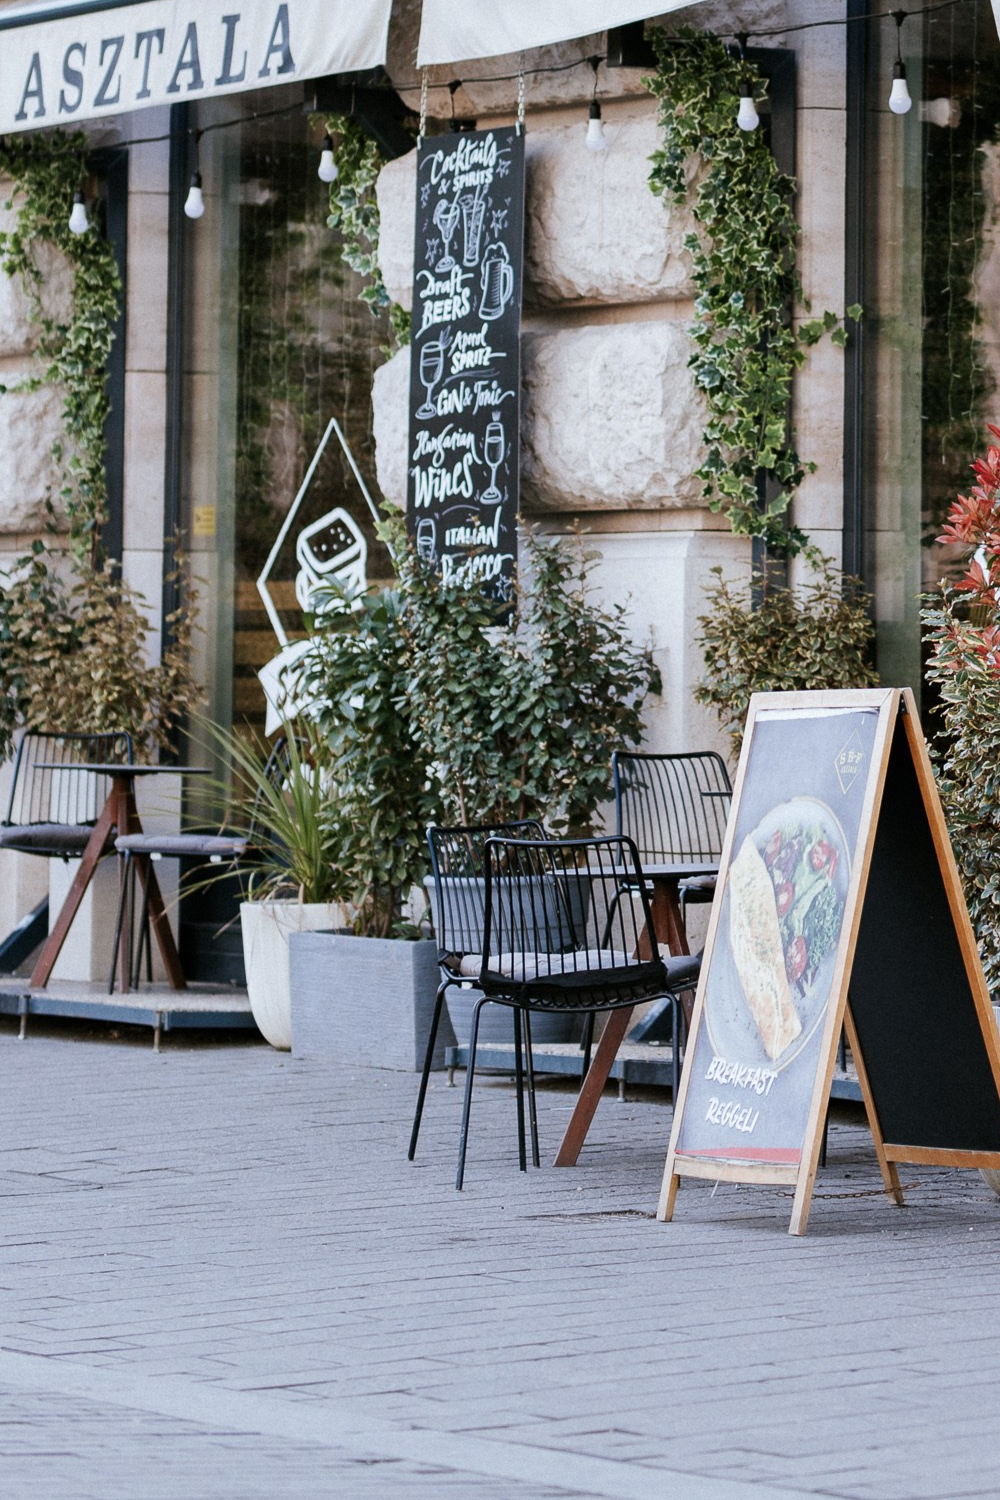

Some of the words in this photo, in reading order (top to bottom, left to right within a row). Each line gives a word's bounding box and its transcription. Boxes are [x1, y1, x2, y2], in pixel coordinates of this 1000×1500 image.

[14, 3, 296, 121] ASZTALA
[420, 132, 511, 185] Cocktails
[438, 181, 450, 195] &
[452, 167, 493, 192] SPIRITS
[415, 264, 475, 299] Draft
[415, 287, 471, 340] BEERS
[450, 346, 507, 375] SPRITZ
[472, 380, 515, 416] Tonic
[413, 423, 482, 468] Hungarian
[411, 452, 474, 508] Wines
[445, 506, 502, 548] ITALIAN
[705, 1056, 778, 1096] BREAKFAST
[705, 1097, 760, 1134] REGGELI
